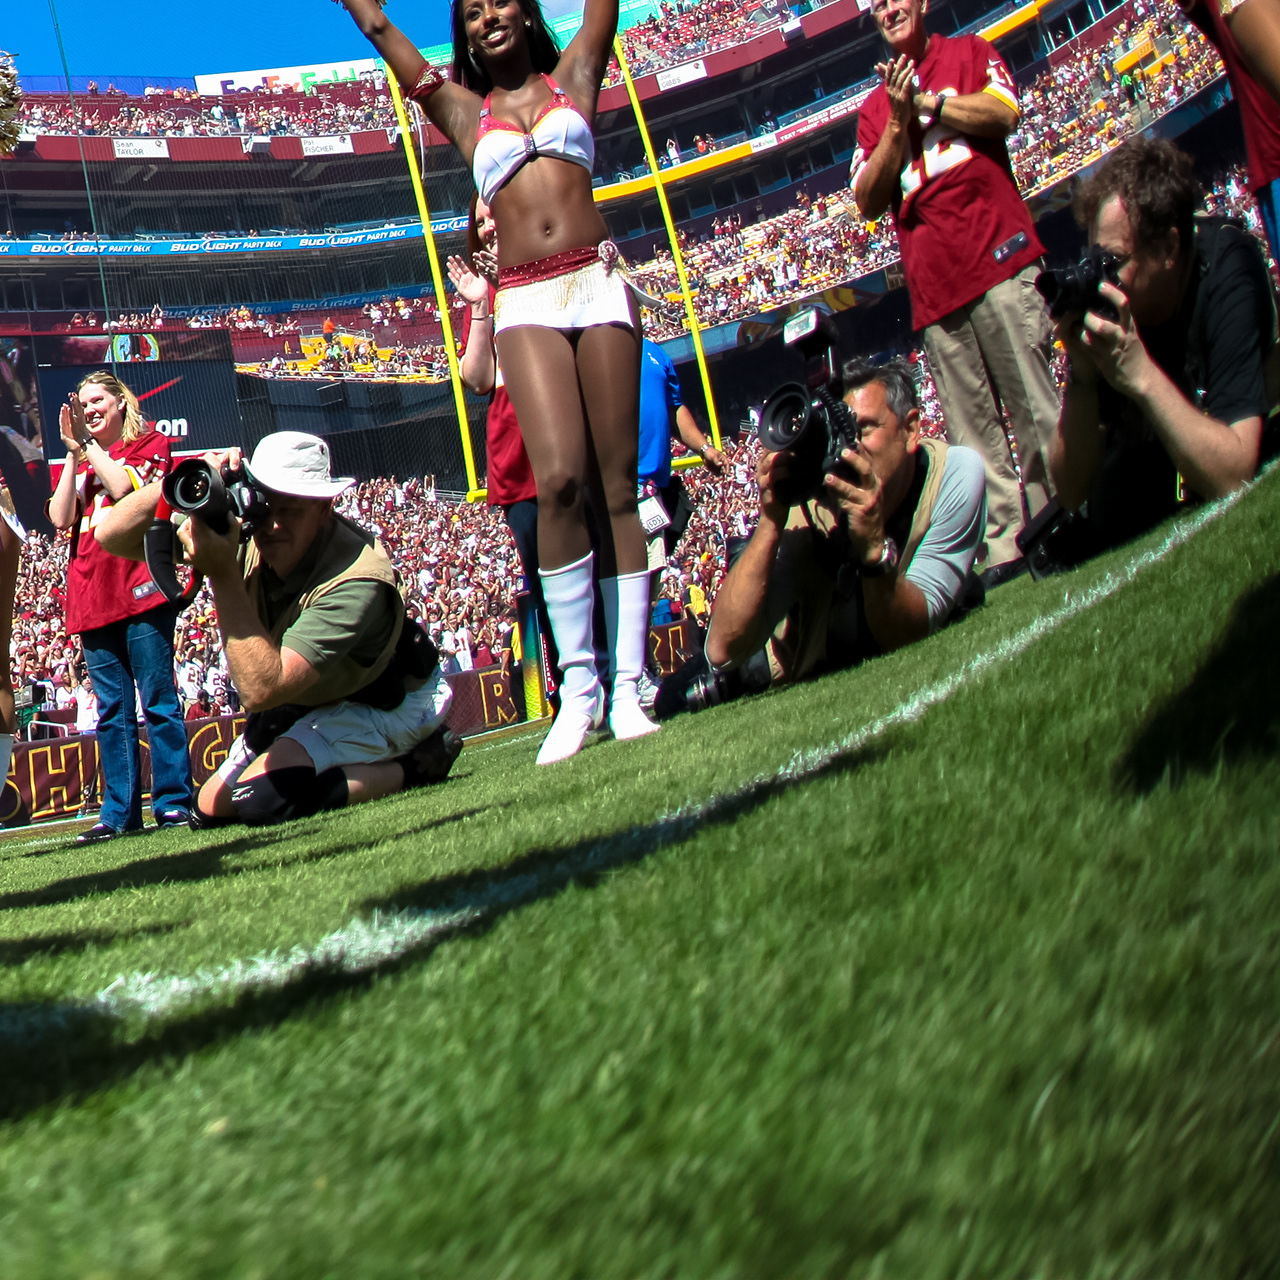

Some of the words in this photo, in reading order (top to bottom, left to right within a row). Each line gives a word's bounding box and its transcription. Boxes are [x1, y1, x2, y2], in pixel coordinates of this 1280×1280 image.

[659, 73, 673, 81] Joe
[661, 77, 682, 89] GIBBS
[115, 140, 134, 148] Sean
[305, 144, 334, 153] FISCHER
[116, 147, 145, 156] TAYLOR
[299, 238, 326, 247] BUD
[330, 234, 367, 246] LIGHT
[366, 231, 389, 241] PARTY
[388, 228, 407, 238] DECK
[30, 244, 63, 253] BUD
[67, 244, 108, 254] LIGHT
[108, 245, 133, 253] PARTY
[132, 244, 152, 253] DECK
[170, 242, 199, 252] BUD
[204, 241, 241, 252] LIGHT
[242, 240, 265, 249] PARTY
[264, 239, 283, 248] DECK
[291, 303, 317, 312] BUD
[321, 297, 359, 308] LIGHT
[649, 517, 662, 528] SDS
